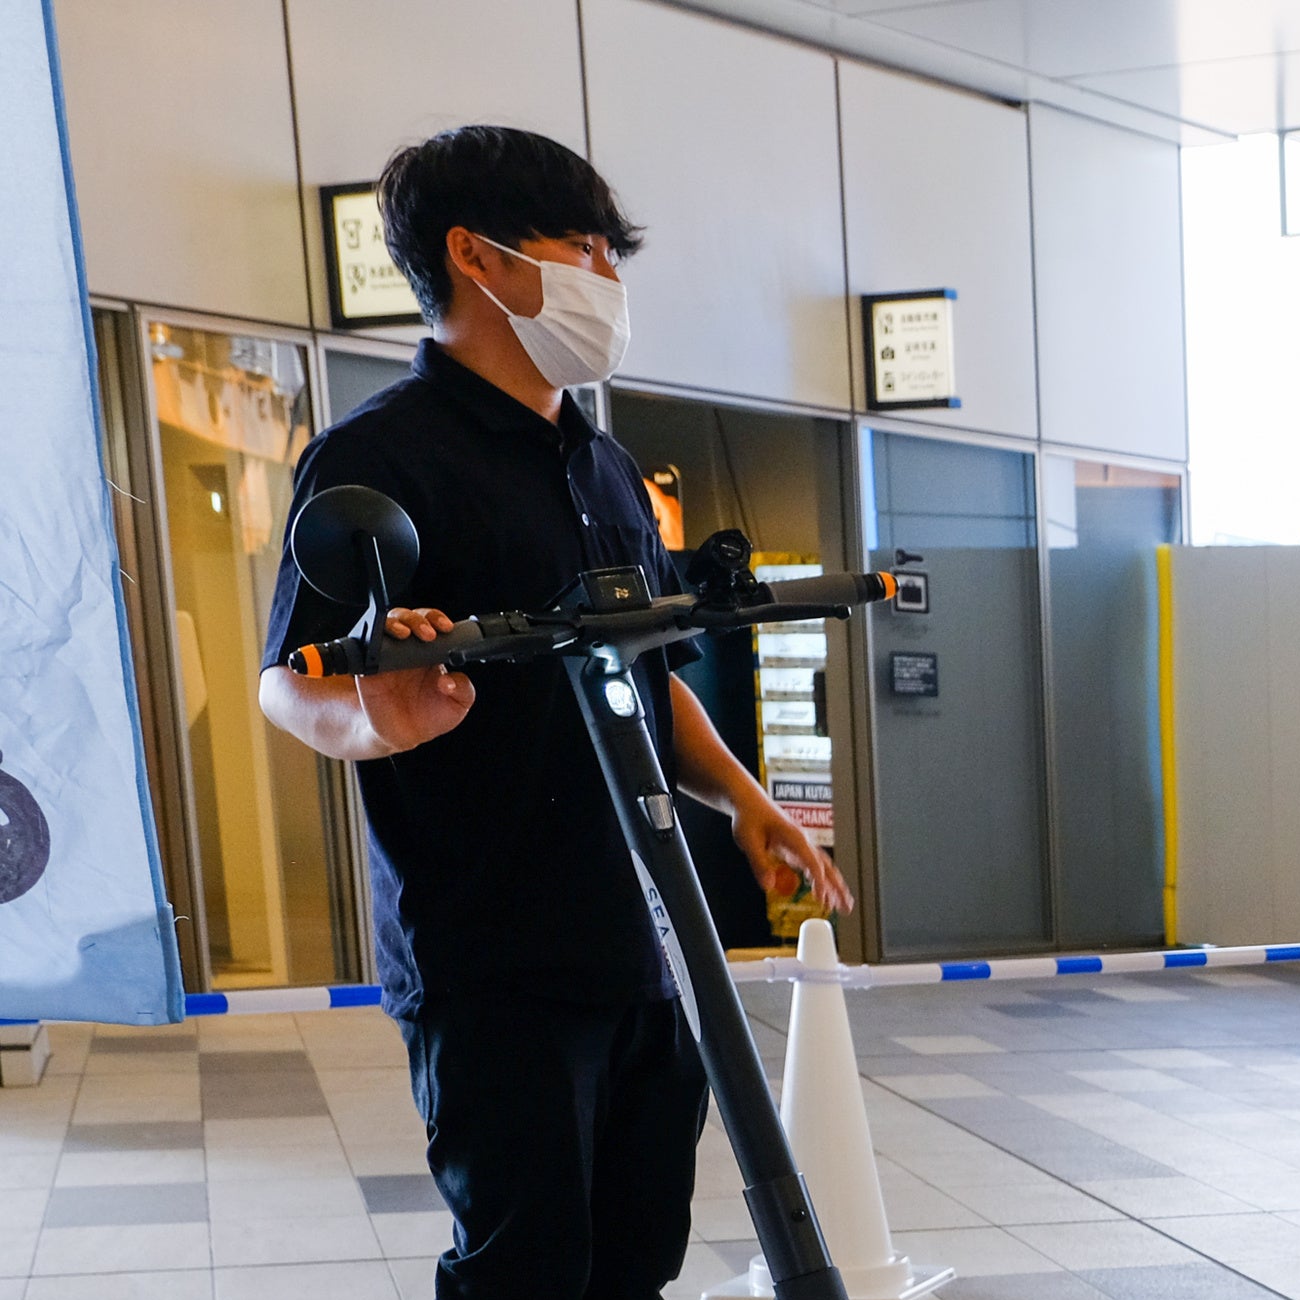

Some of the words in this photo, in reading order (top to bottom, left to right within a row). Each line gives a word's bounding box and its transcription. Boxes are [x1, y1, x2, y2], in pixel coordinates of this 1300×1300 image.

[775, 784, 803, 800] JAPAN
[804, 784, 833, 801] KUTA
[648, 887, 670, 941] SEA
